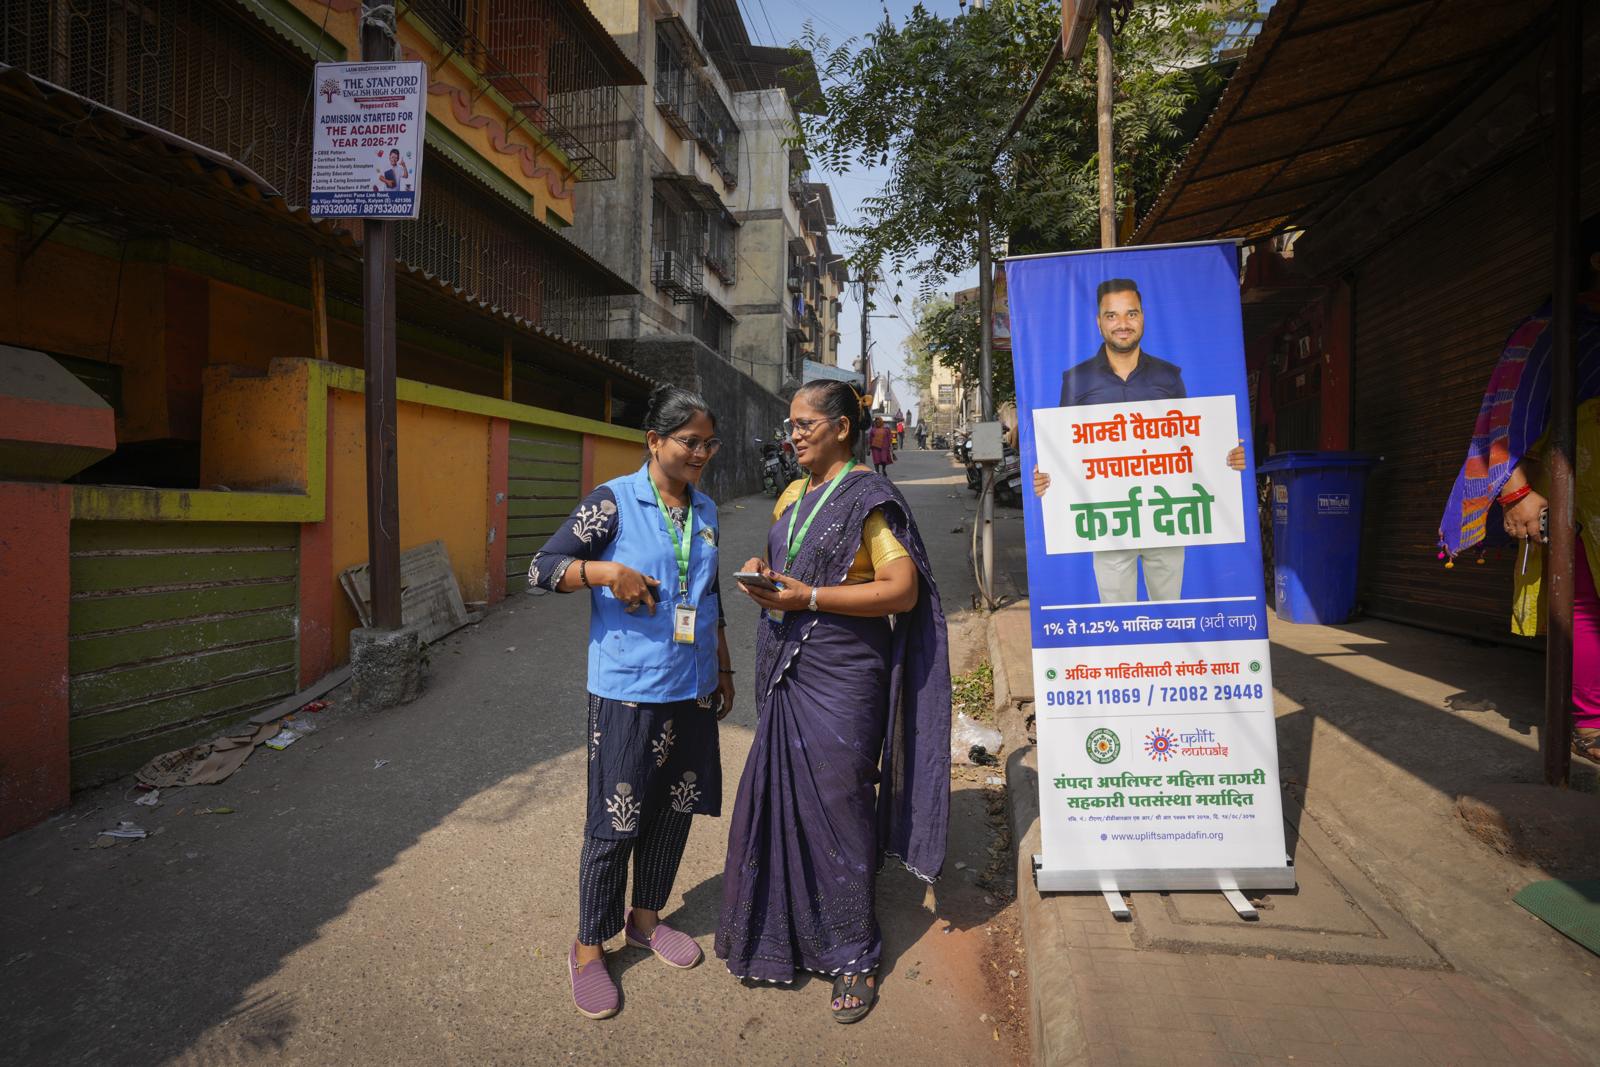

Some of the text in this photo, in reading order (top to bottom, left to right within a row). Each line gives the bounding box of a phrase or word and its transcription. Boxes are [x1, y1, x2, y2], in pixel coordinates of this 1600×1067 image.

[344, 76, 417, 89] THE STANFORD
[321, 112, 413, 124] ADMISSION STARTED FOR
[326, 124, 406, 135] THE ACADEMIC
[332, 137, 399, 147] YEAR 2026-27
[311, 204, 357, 214] 8879320005
[364, 204, 412, 214] 8879320007
[1072, 410, 1201, 444] आम्ही वैद्यकीय
[1082, 446, 1193, 480] उपचारांसाठी
[1070, 483, 1215, 541] कर्ज देतो
[1043, 613, 1257, 636] 1% ते 1.25% मासिक व्याज (अटी लागू)
[1065, 660, 1240, 681] अधिक माहितीसाठी संपर्क साधा
[1047, 684, 1263, 706] 90821 11869 / 72082 29448
[1180, 728, 1215, 747] uplift
[1182, 742, 1229, 758] mutuals
[1054, 768, 1265, 789] संपदा अपलिफ्ट महिला नागरी
[1067, 789, 1254, 809] सहकारी पतसंस्था मर्यादित
[1112, 831, 1223, 841] www.upliftsampadafin.org
